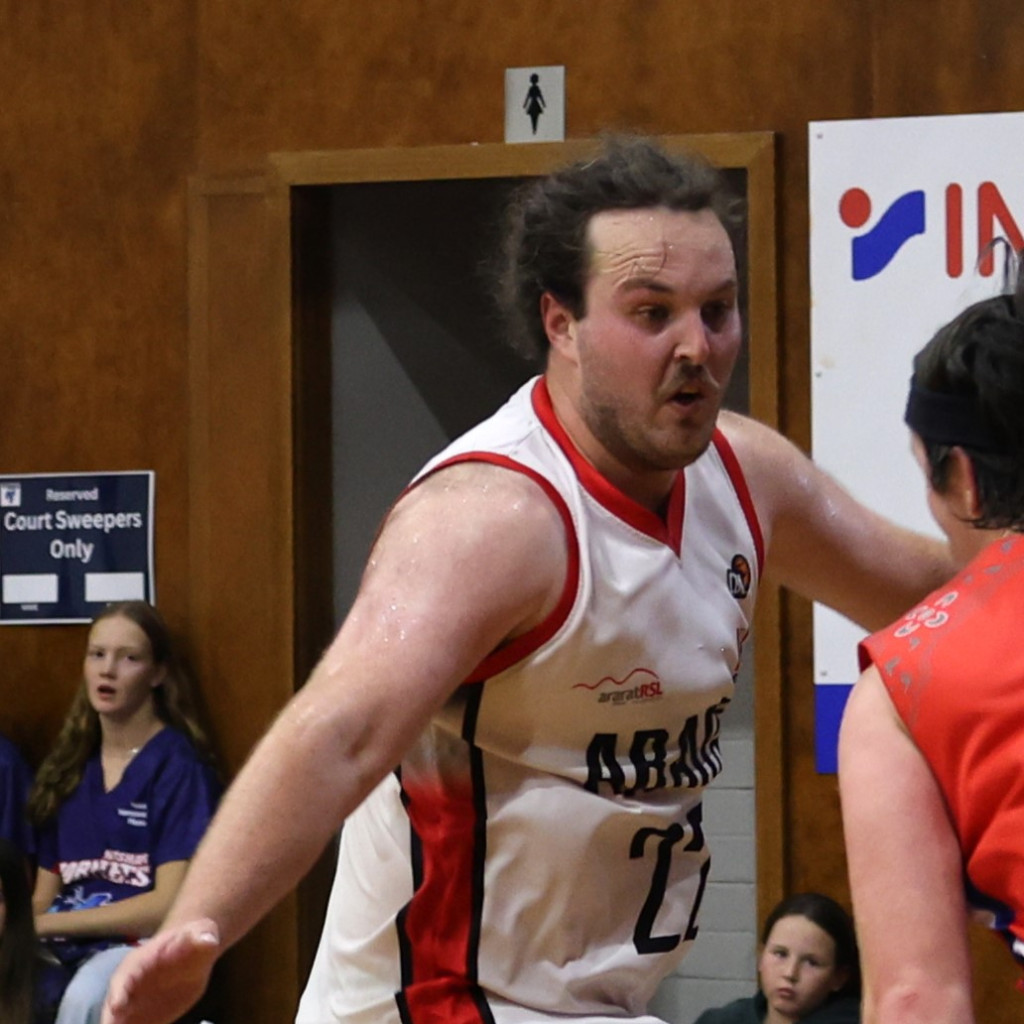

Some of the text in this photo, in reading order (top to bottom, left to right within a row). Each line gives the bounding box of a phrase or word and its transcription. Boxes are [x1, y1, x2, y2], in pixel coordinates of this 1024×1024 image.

[45, 487, 99, 501] Reserved
[3, 510, 143, 533] Court Sweepers
[49, 538, 94, 563] Only
